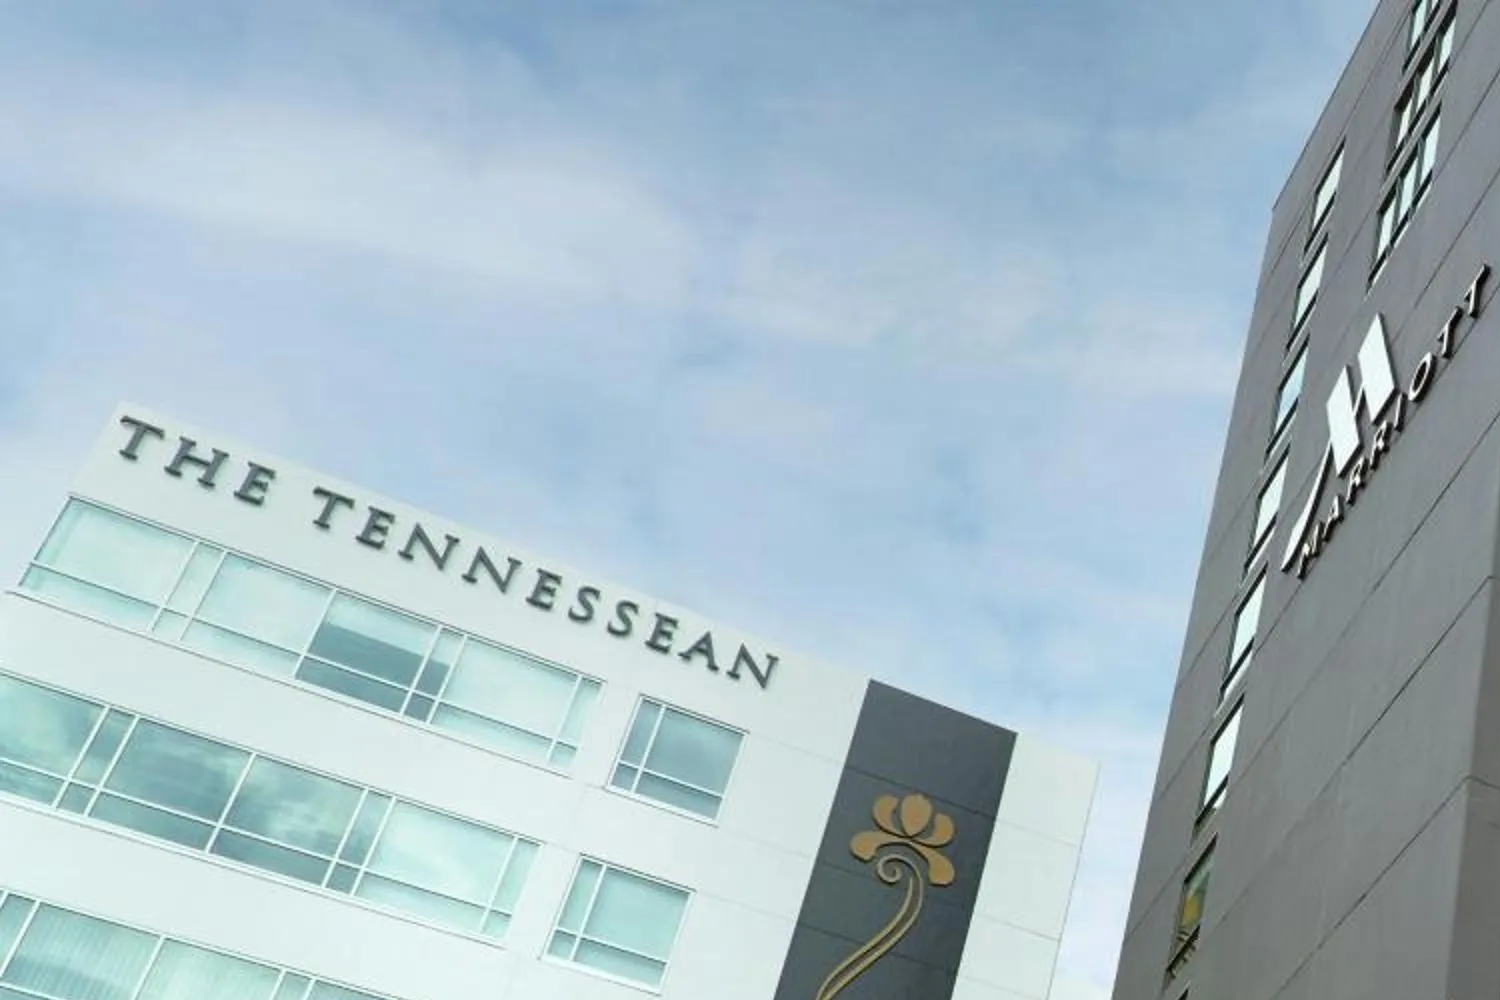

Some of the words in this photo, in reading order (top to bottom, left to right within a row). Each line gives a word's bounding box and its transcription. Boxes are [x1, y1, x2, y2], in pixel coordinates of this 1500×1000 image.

[119, 415, 276, 506] THE
[312, 486, 780, 690] TENNESSEAN
[1297, 264, 1491, 581] MARRIOTT
